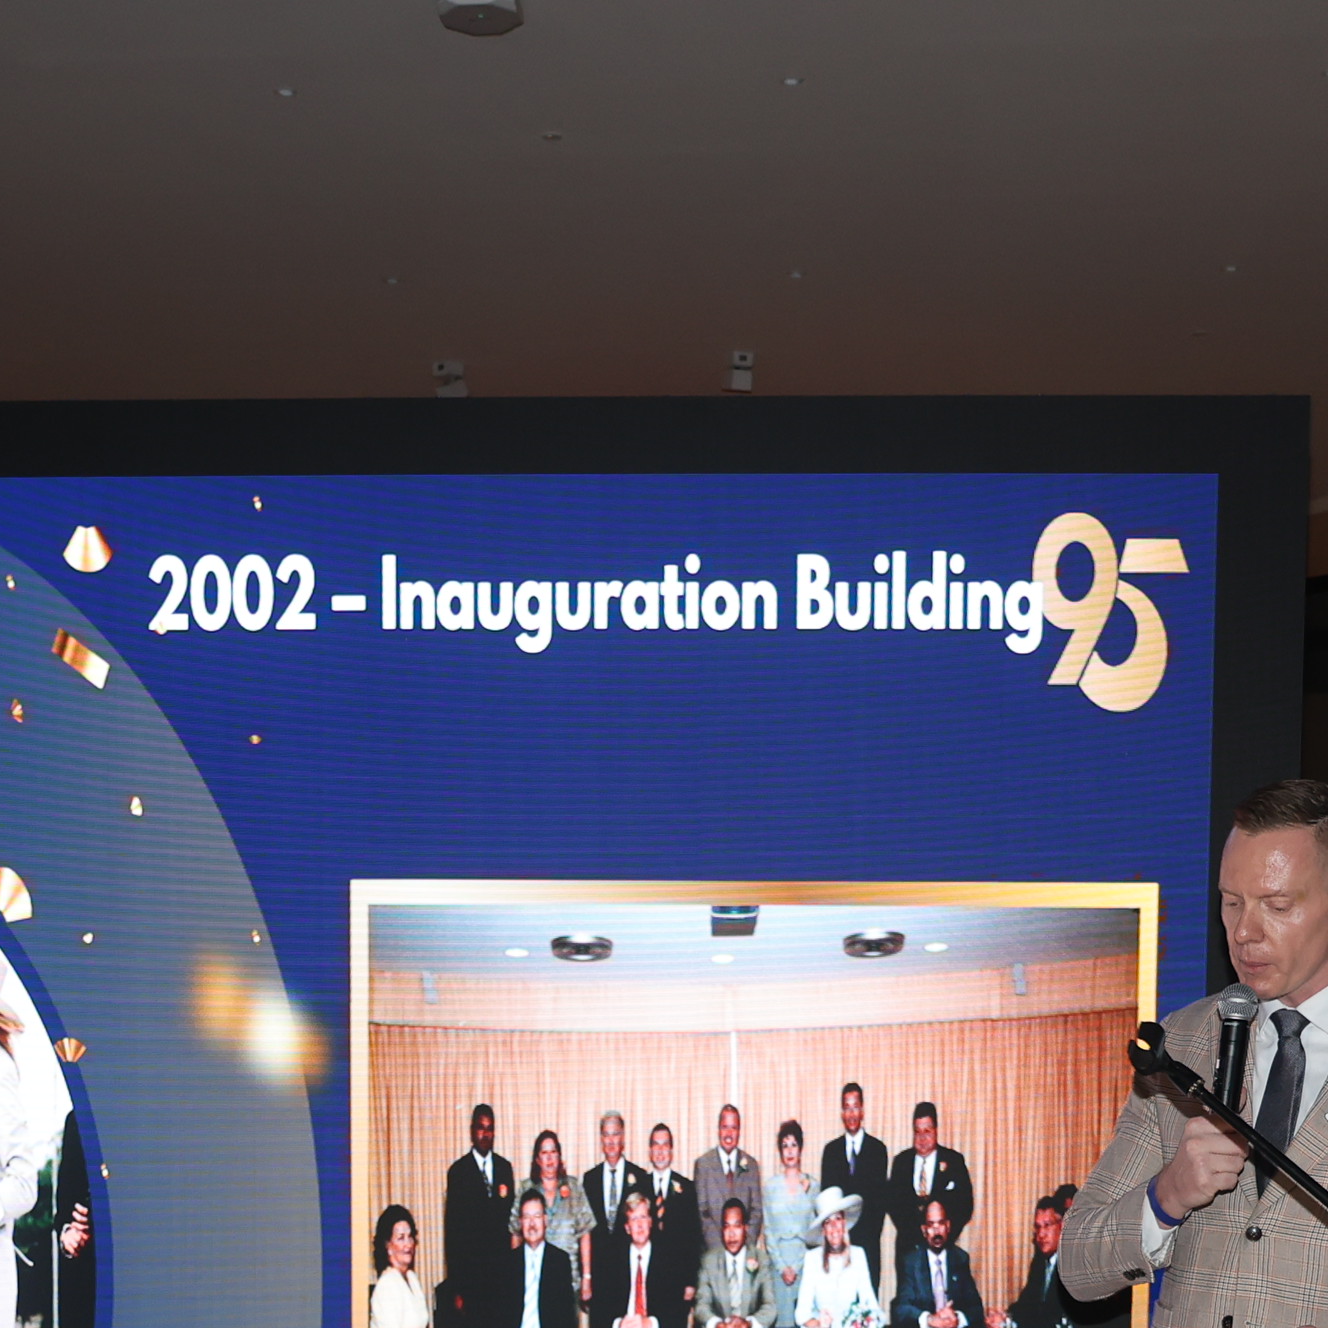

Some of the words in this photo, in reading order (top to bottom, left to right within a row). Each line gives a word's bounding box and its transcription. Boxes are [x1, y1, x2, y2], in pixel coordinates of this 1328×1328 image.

[148, 553, 316, 632] 2002
[381, 553, 778, 654] Inauguration
[796, 550, 1044, 654] Building
[1032, 512, 1190, 712] 95
